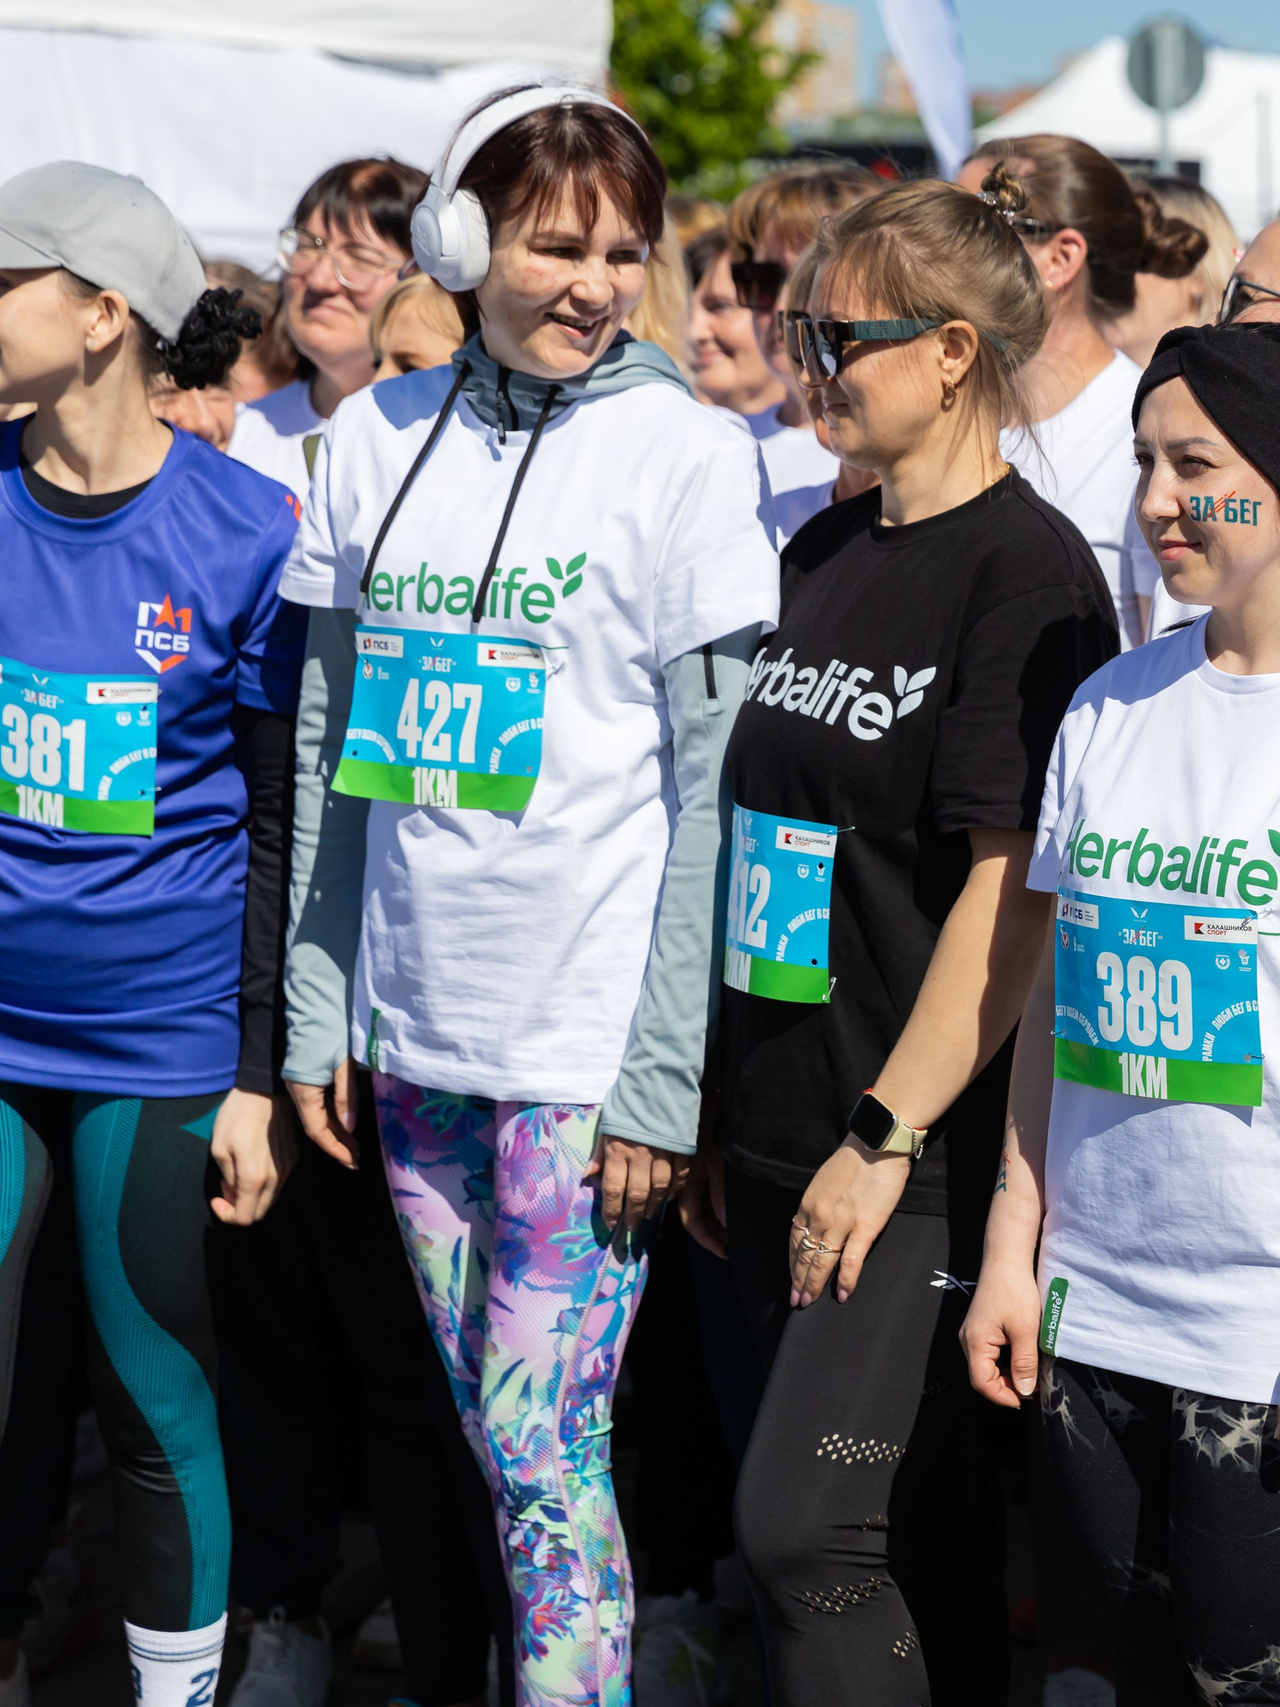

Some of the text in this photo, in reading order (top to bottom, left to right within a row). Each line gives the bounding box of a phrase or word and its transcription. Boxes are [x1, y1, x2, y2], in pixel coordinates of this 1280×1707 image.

[1224, 496, 1262, 527] БЕГ
[135, 628, 191, 653] ПСБ
[1, 703, 86, 792] 381
[396, 677, 483, 764] 427
[795, 835, 830, 846] КАЛАШНИКОВ
[728, 857, 771, 949] 412
[1207, 924, 1252, 932] КАЛАШНИКОВ
[1096, 951, 1193, 1052] 389
[1202, 1032, 1216, 1062] РАМКИ
[1230, 1001, 1245, 1016] БЕГ
[1245, 1000, 1252, 1012] В
[1046, 1297, 1063, 1349] Herbalife
